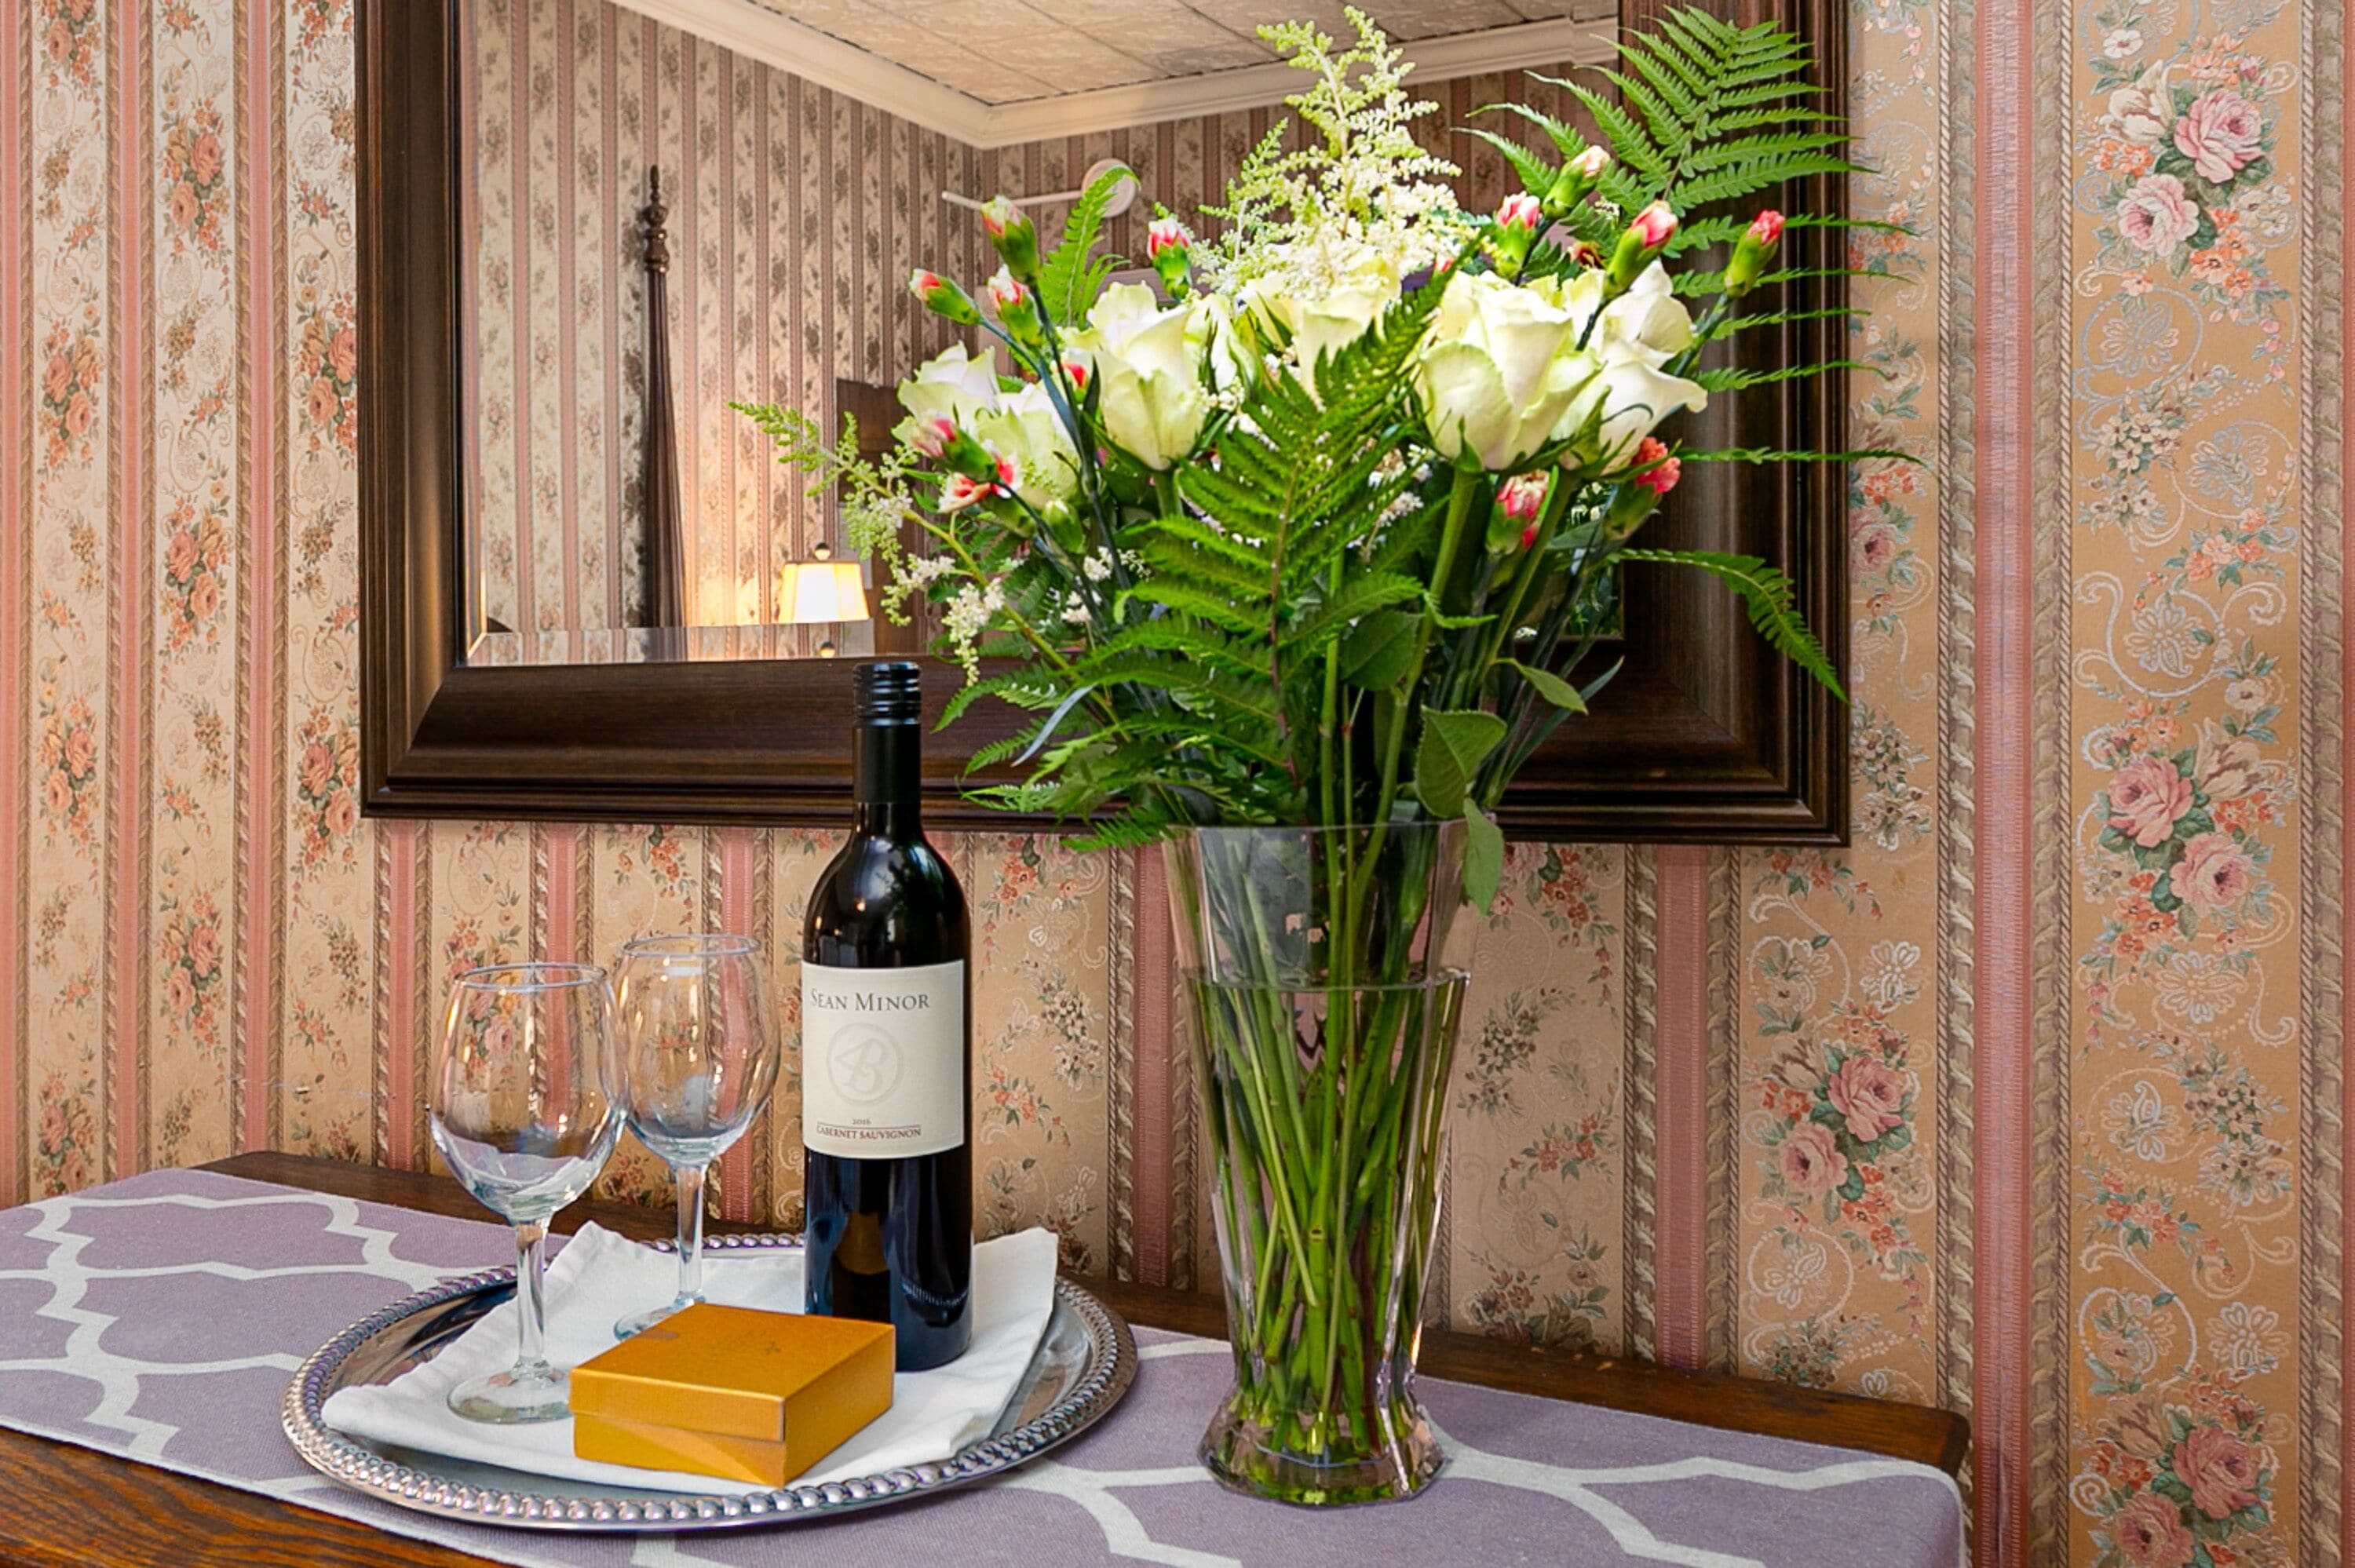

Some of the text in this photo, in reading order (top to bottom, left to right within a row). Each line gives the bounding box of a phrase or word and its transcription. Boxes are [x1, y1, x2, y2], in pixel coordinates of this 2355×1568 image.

[811, 988, 929, 1011] SEAN MINOR
[816, 1125, 922, 1139] CABERNET SAUVIGNON
